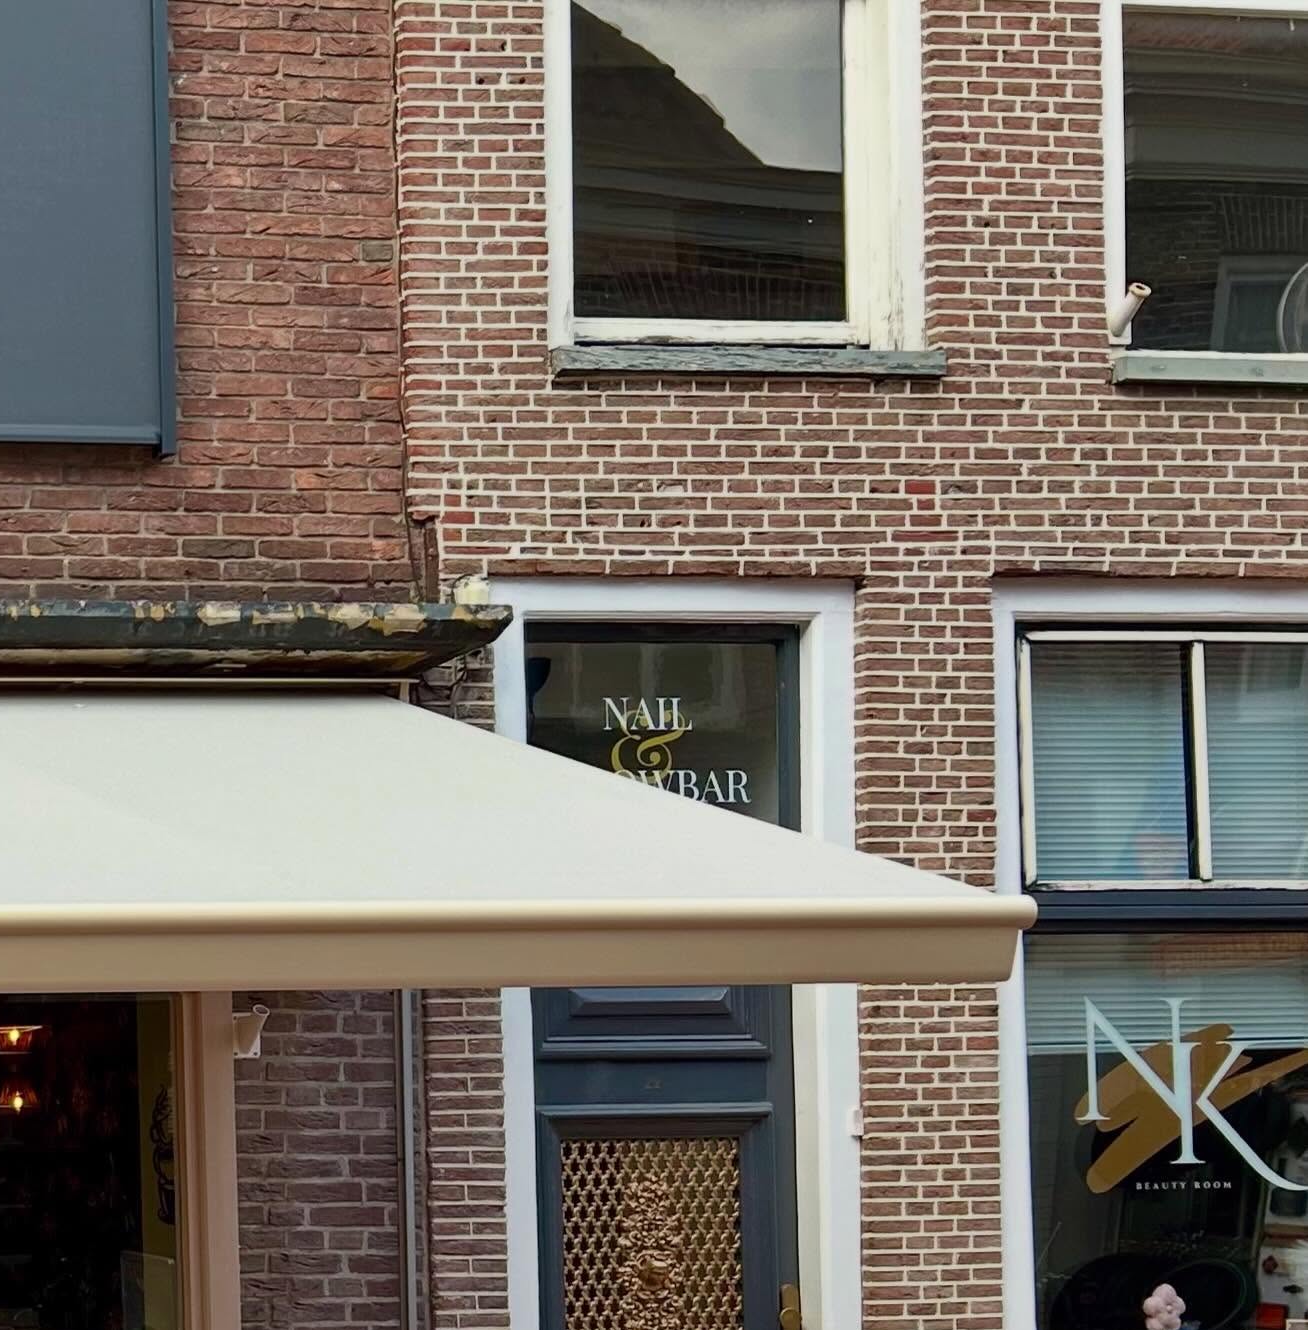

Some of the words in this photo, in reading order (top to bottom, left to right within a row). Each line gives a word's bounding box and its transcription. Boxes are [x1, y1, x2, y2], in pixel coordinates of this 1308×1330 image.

[602, 697, 693, 731] NAIL
[1074, 996, 1308, 1191] NK
[1135, 1181, 1187, 1190] BEAUTY
[1194, 1180, 1233, 1190] ROOM
